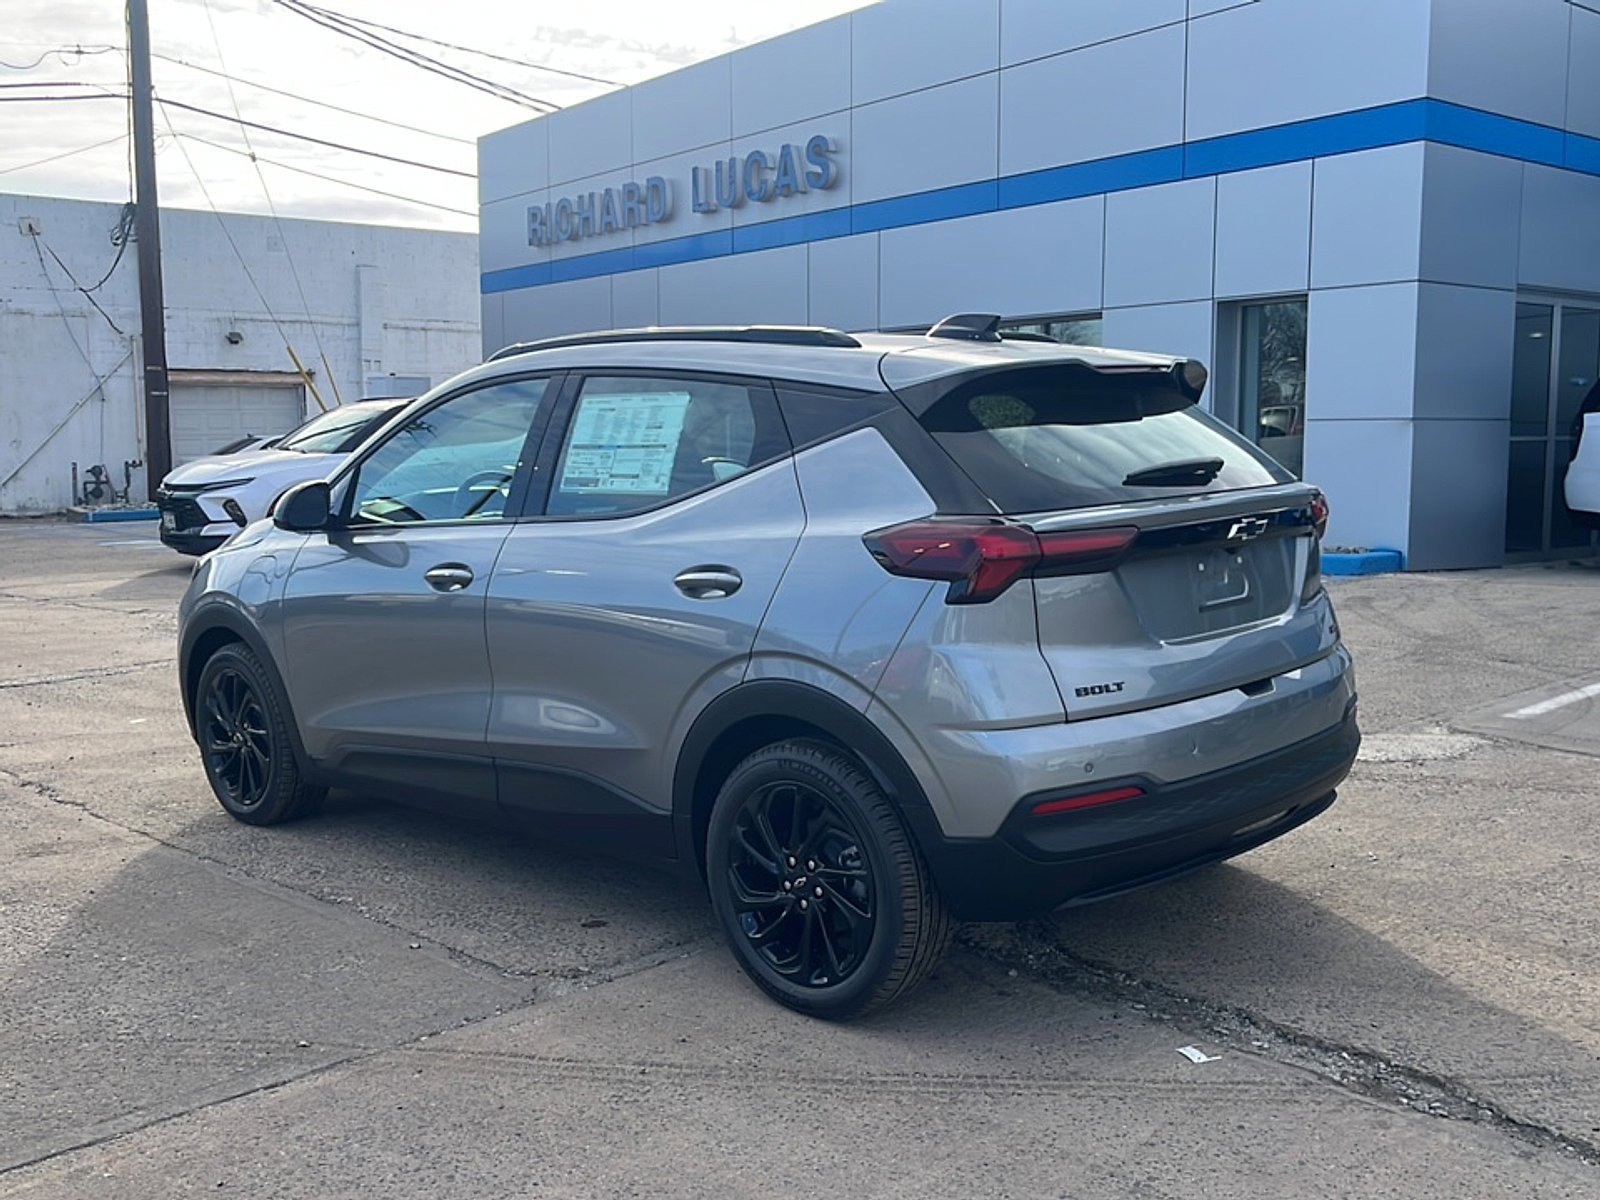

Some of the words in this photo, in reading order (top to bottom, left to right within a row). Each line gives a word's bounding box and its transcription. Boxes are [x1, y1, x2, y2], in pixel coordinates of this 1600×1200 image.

[527, 176, 672, 247] RICHARD
[691, 135, 838, 214] LUCAS
[1075, 681, 1125, 697] BOLT
